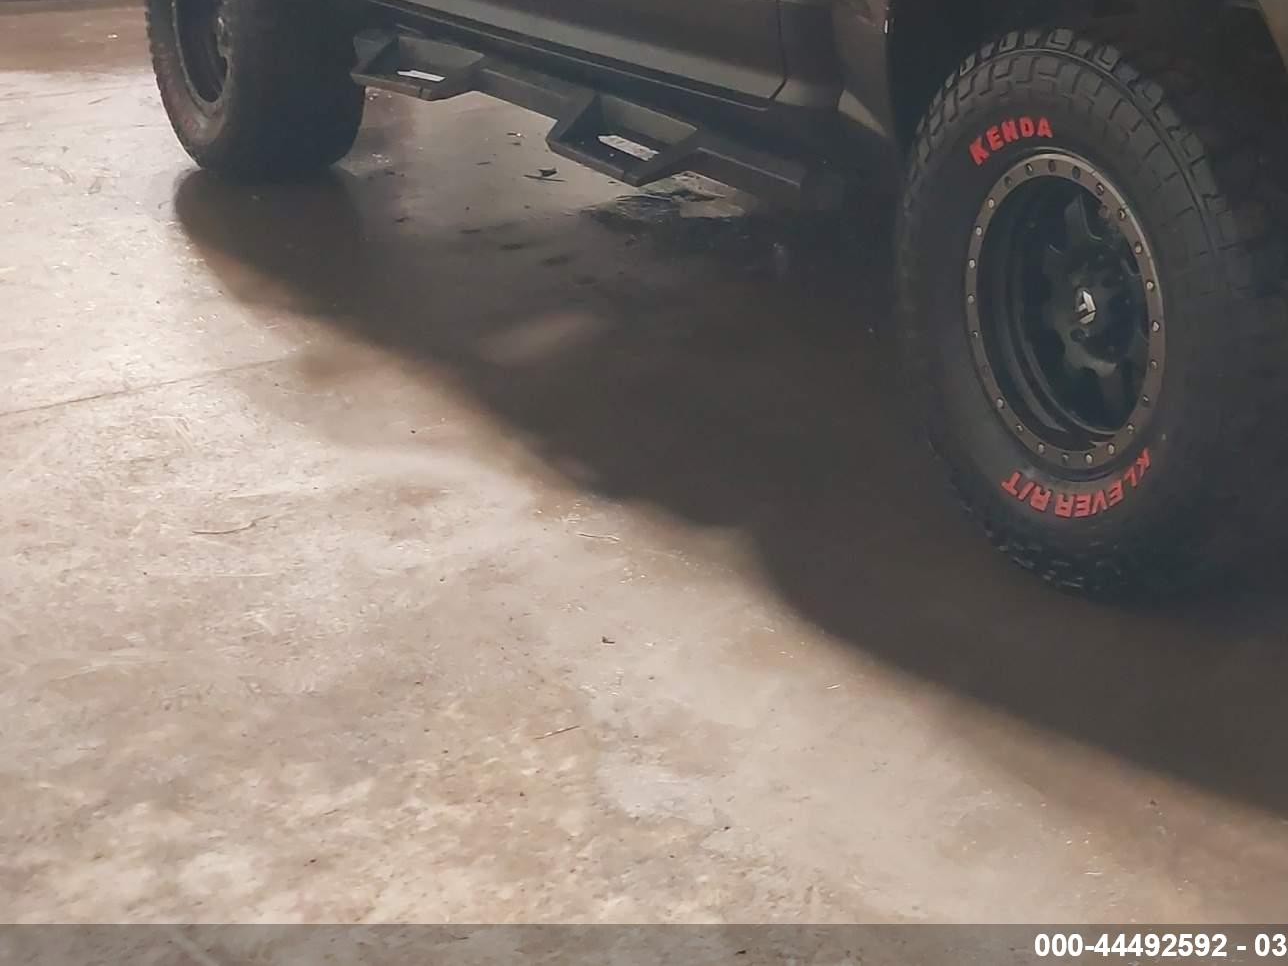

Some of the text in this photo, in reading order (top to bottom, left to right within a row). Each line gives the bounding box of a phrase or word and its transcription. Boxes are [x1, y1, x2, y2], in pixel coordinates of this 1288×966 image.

[969, 116, 1053, 165] KENDA
[1000, 448, 1152, 519] KLEVER R/T
